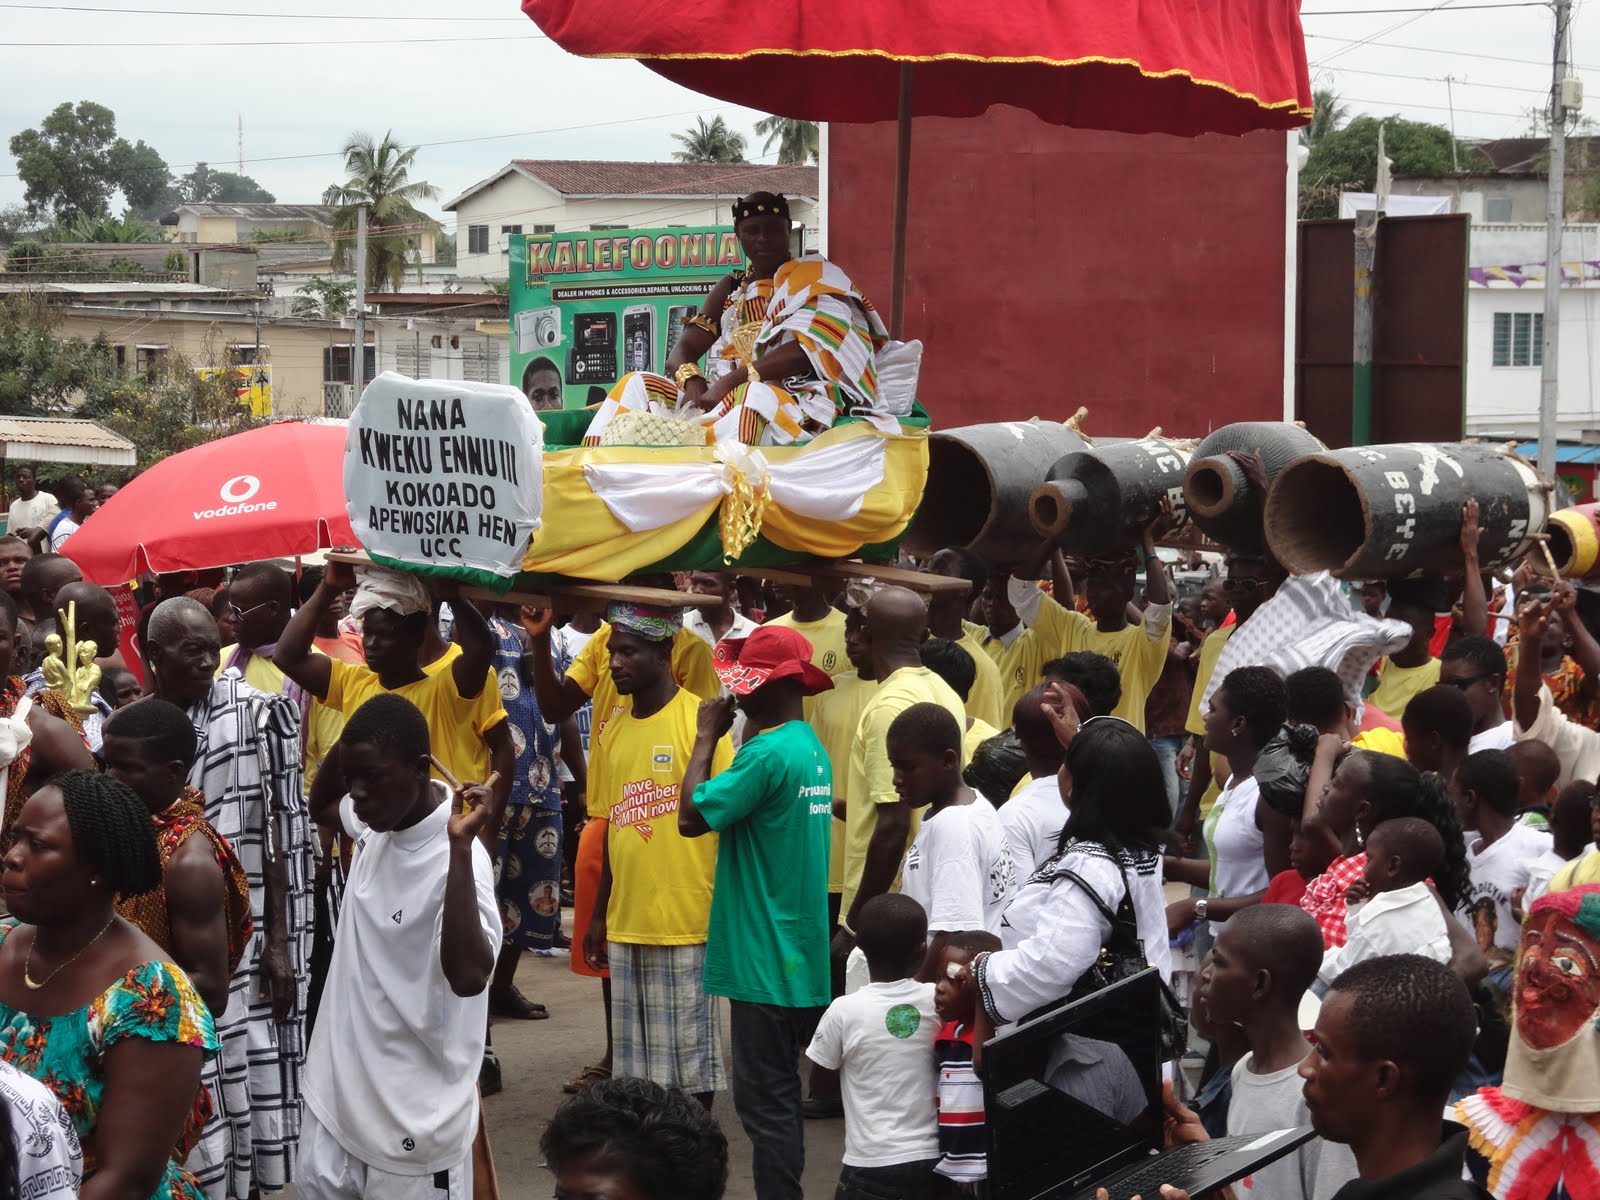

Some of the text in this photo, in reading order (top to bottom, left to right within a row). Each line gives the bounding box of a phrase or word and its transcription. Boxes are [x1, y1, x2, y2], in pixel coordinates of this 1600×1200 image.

[529, 232, 743, 275] KALEFOONIA
[557, 290, 577, 298] DEALER
[578, 289, 583, 297] IN
[584, 288, 605, 297] PHONES
[398, 398, 466, 431] NANA
[359, 427, 433, 475] KWEKU
[385, 479, 496, 510] KOKOADO
[193, 501, 277, 520] vodafone
[368, 505, 517, 547] APEWOSIKA HEN
[420, 537, 463, 558] UCC
[623, 779, 652, 799] Move
[628, 784, 677, 808] number
[621, 805, 647, 826] MTN
[651, 799, 678, 817] now
